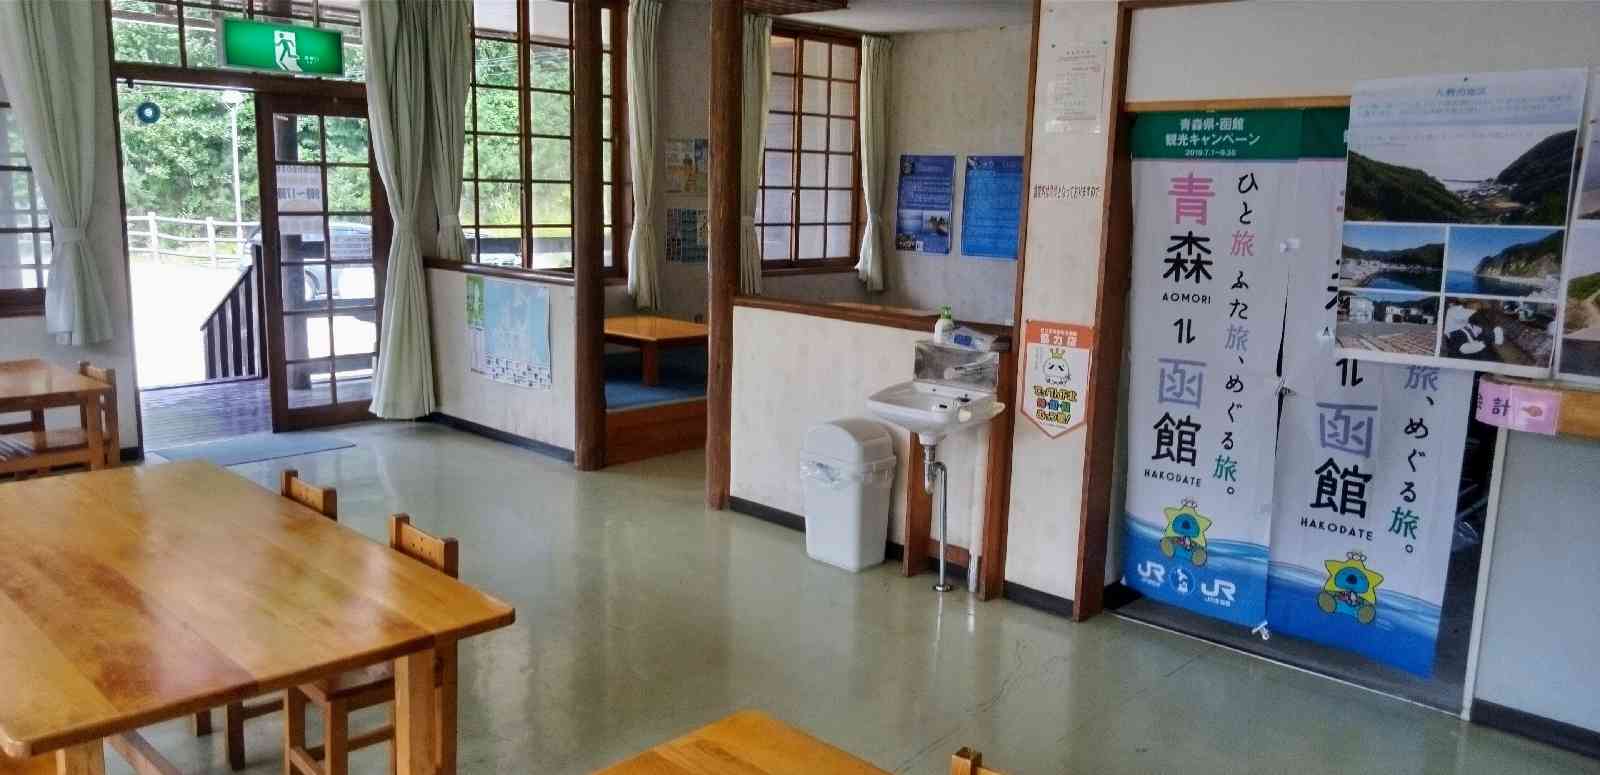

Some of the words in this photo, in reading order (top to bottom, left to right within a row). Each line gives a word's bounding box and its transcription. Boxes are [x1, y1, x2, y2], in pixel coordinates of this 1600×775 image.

[1165, 133, 1260, 147] 観光キャンペーン
[1162, 170, 1216, 284] 青森
[1162, 292, 1212, 304] AOMORI
[1151, 357, 1207, 467] 函館
[1310, 402, 1378, 519] 函館
[1144, 469, 1202, 488] HAKODATE
[1300, 517, 1374, 541] HAKODATE
[1137, 561, 1166, 583] JR
[1201, 579, 1237, 601] JR
